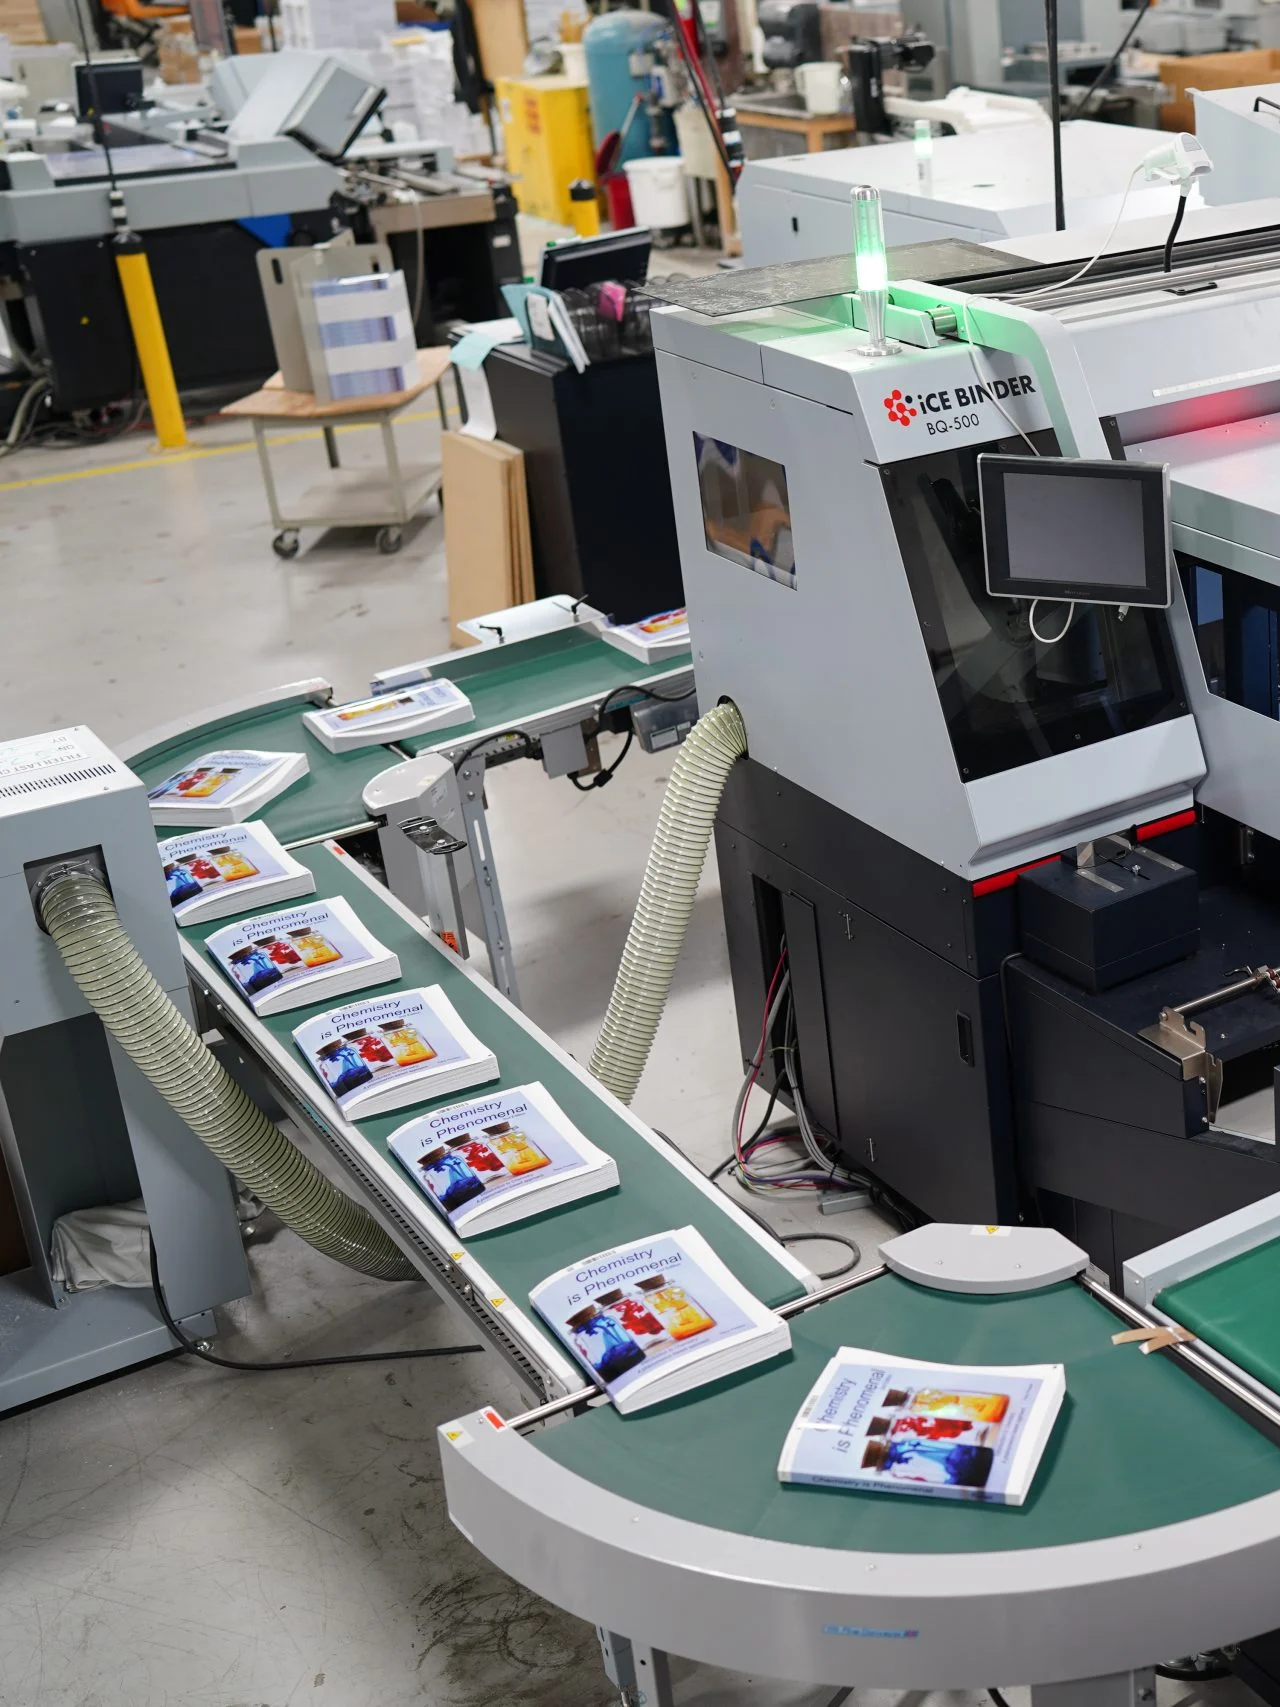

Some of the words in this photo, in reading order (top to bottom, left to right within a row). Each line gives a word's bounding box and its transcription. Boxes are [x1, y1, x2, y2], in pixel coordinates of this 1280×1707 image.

[955, 375, 1037, 407] BINDER
[926, 413, 980, 435] BQ-500
[14, 761, 41, 772] LAST
[43, 753, 81, 765] FILTER
[165, 832, 227, 851] Chemistry
[169, 834, 248, 858] Phenomenal
[232, 938, 243, 947] is
[247, 913, 329, 940] Phenomenal
[242, 911, 308, 933] Chemistry
[320, 1031, 332, 1040] is
[336, 1003, 424, 1033] Phenomenal
[331, 1000, 401, 1024] Chemistry
[420, 1137, 433, 1148] is
[436, 1103, 528, 1139] Phenomenal
[429, 1101, 503, 1129] Chemistry
[575, 1249, 654, 1283] Chemistry
[567, 1295, 581, 1306] is
[584, 1252, 683, 1296] Phenomenal
[832, 1440, 851, 1453] is
[812, 1475, 859, 1488] Chemistry
[873, 1480, 934, 1494] Phenomenal
